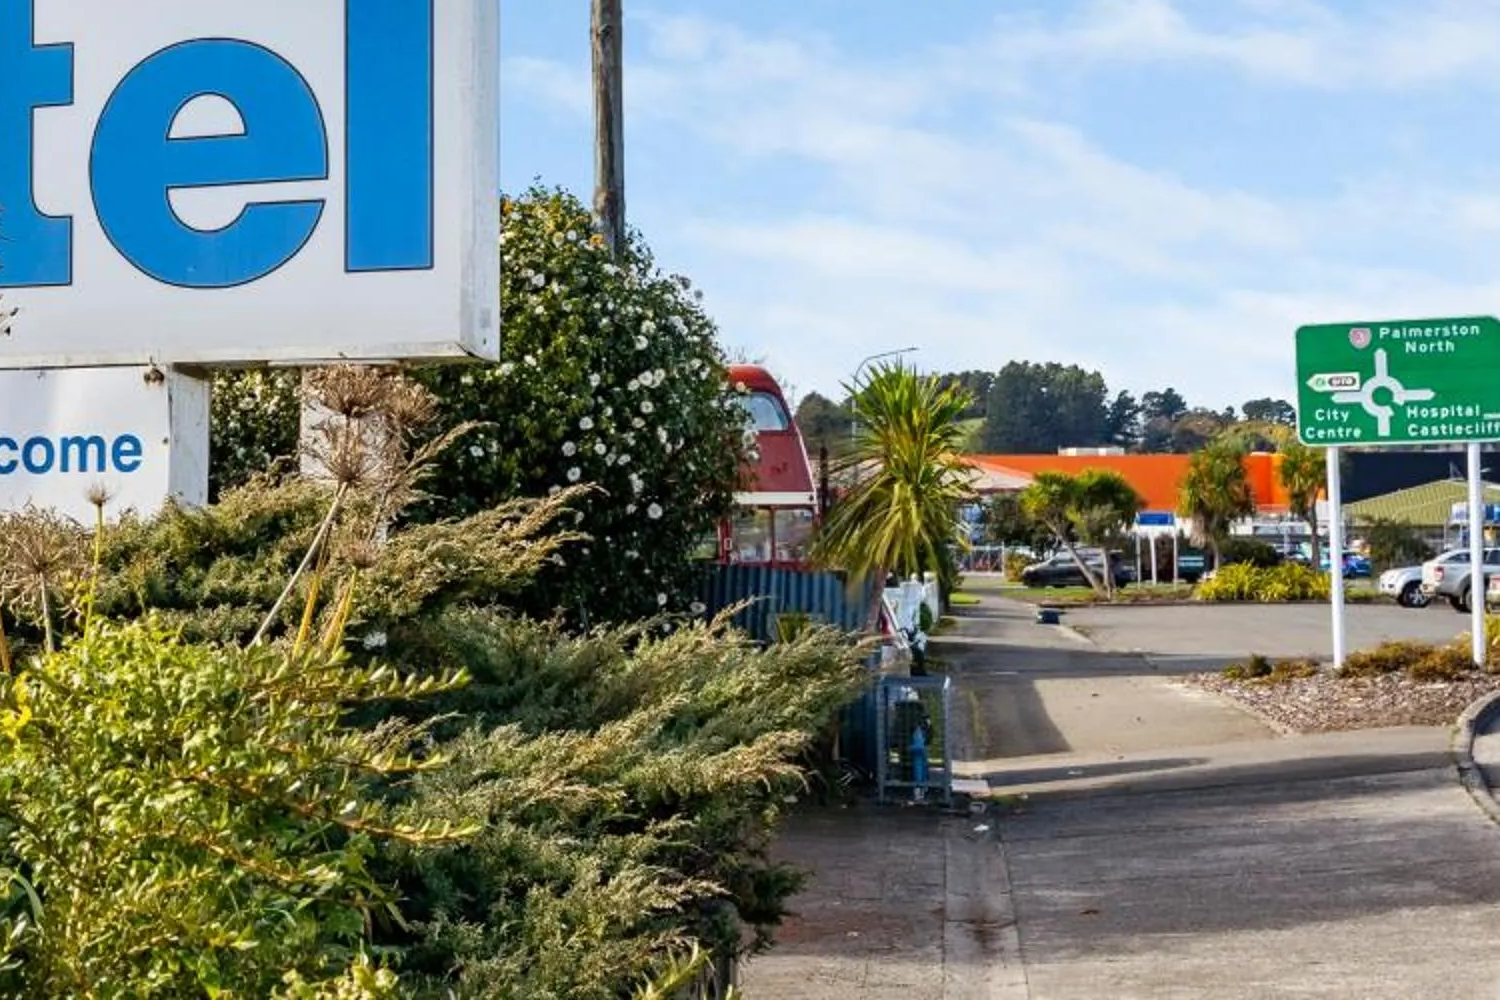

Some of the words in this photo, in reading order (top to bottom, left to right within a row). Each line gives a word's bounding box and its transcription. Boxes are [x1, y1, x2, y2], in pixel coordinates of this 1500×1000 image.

[1379, 324, 1480, 340] Palmerston
[1405, 340, 1455, 353] North
[1315, 408, 1350, 422] City
[1406, 404, 1480, 419] Hospital
[1305, 425, 1362, 439] Centre
